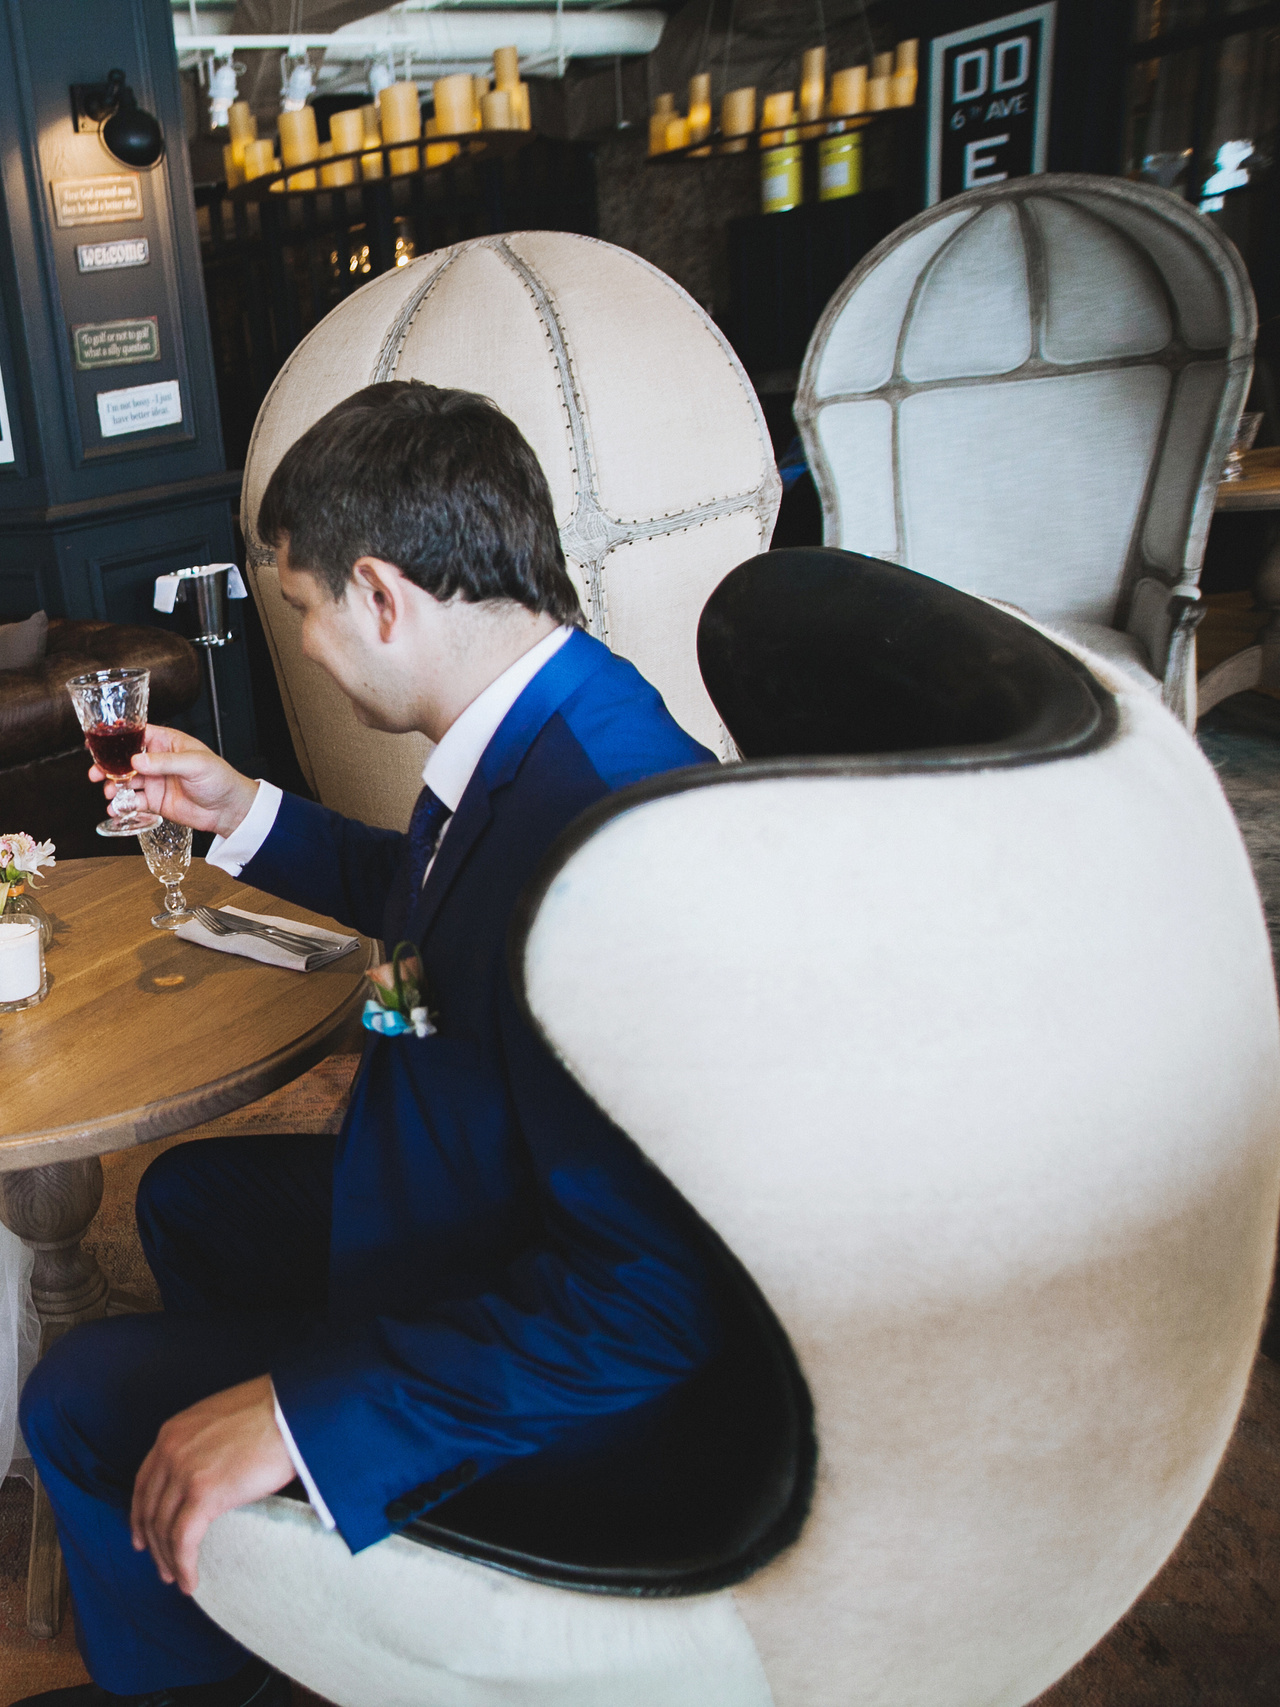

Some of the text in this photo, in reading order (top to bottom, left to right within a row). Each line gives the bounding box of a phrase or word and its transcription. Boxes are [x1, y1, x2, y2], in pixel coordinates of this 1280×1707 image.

[984, 92, 1029, 122] AVE
[963, 133, 1010, 189] E
[81, 242, 146, 267] WELCOME
[82, 333, 92, 344] To
[92, 331, 107, 346] golf
[107, 332, 116, 341] or
[116, 331, 127, 341] not
[135, 326, 150, 341] golf
[84, 347, 101, 358] what
